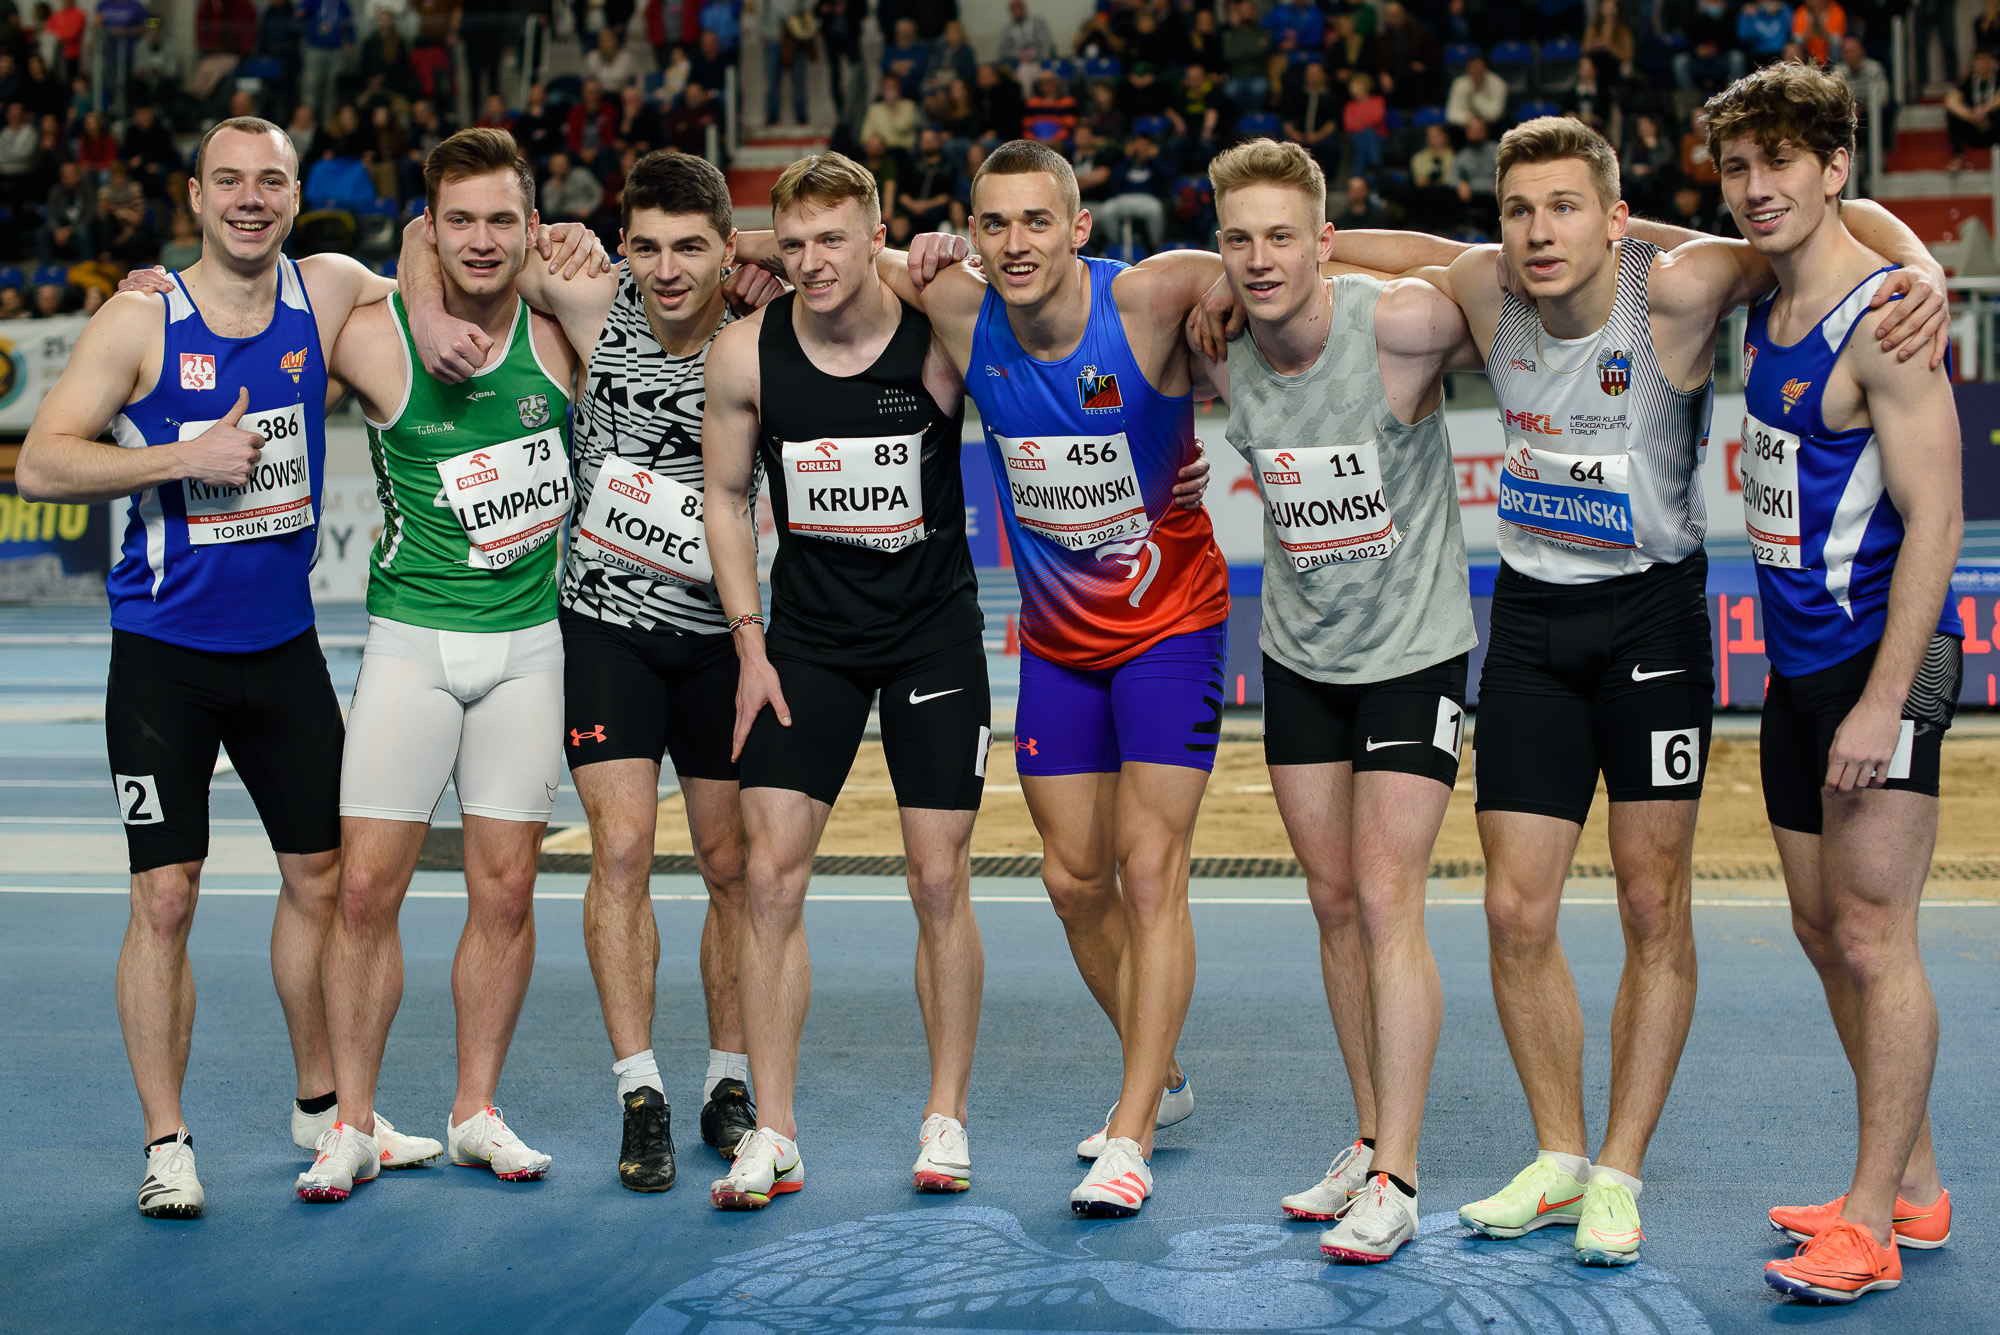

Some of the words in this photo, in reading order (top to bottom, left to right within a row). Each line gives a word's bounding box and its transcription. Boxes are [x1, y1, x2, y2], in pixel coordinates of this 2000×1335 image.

[281, 347, 307, 368] AWF
[1781, 378, 1811, 399] AWF
[879, 405, 917, 414] DIVISION
[1085, 407, 1121, 415] SZCZECIN
[1570, 414, 1601, 422] MIEJSKI
[1602, 414, 1626, 422] KLUB
[257, 413, 298, 442] 386
[1506, 409, 1562, 435] MKL
[1570, 421, 1632, 430] LEKKOATLETY
[1570, 428, 1598, 436] TORUŃ
[522, 439, 550, 466] 73
[874, 443, 908, 466] 83
[1066, 442, 1118, 465] 456
[1754, 431, 1785, 464] 384
[799, 461, 839, 471] ORLEN
[1010, 459, 1044, 469] ORLEN
[1329, 453, 1365, 478] 11
[1509, 459, 1537, 478] ORLEN
[1570, 461, 1604, 484] 64
[188, 456, 306, 500] KWKOWSKI
[459, 469, 497, 488] ORLEN
[1266, 473, 1299, 483] ORLEN
[611, 480, 649, 503] ORLEN
[808, 485, 909, 511] KRUPA
[1012, 475, 1135, 510] SŁOWIKOWSKI
[1741, 467, 1792, 518] ZŁOWSKI
[228, 511, 254, 520] HALOWE
[459, 477, 569, 531] LEMPACH
[1501, 483, 1627, 532] BRZEZIŃSKI
[213, 517, 268, 539] TORUŃ
[273, 513, 302, 531] 2022
[605, 506, 701, 564] KOPEĆ
[1068, 519, 1112, 531] MISTRZOSTWA
[1088, 525, 1125, 544] 2022
[488, 539, 530, 566] TORUŃ
[872, 535, 908, 549] 2022
[1301, 542, 1326, 550] HALOWE
[1327, 535, 1372, 547] MISTRZOSTWA
[1348, 543, 1388, 560] 2022
[1751, 542, 1774, 561] 022
[598, 549, 646, 575] TORUŃ
[1958, 597, 2000, 654] 1
[1665, 734, 1691, 780] 6
[124, 780, 153, 820] 2
